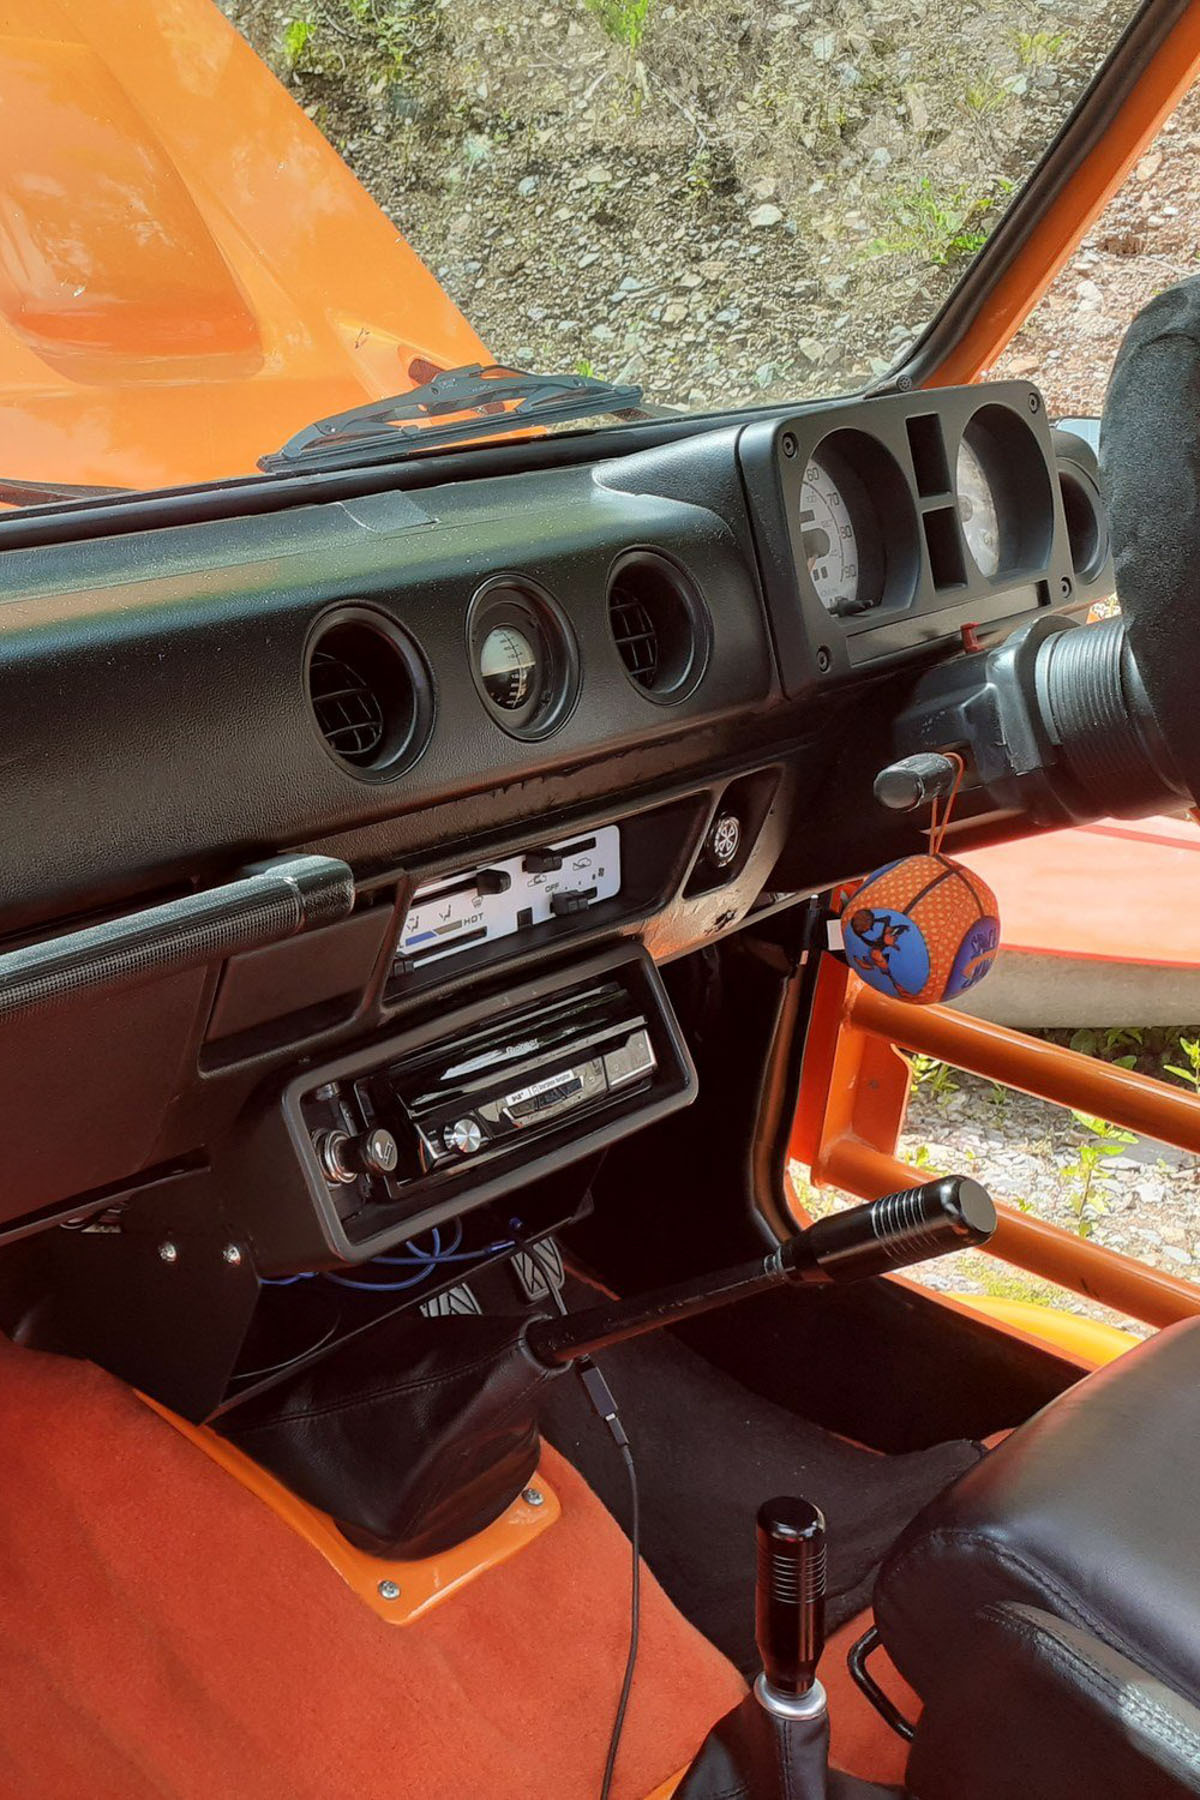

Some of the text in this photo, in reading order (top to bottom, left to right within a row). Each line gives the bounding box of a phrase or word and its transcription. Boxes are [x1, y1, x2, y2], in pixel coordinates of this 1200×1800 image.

[806, 466, 820, 482] 60
[826, 491, 840, 506] 70
[839, 525, 853, 540] 80
[545, 882, 560, 893] OFF
[463, 912, 485, 926] HOT
